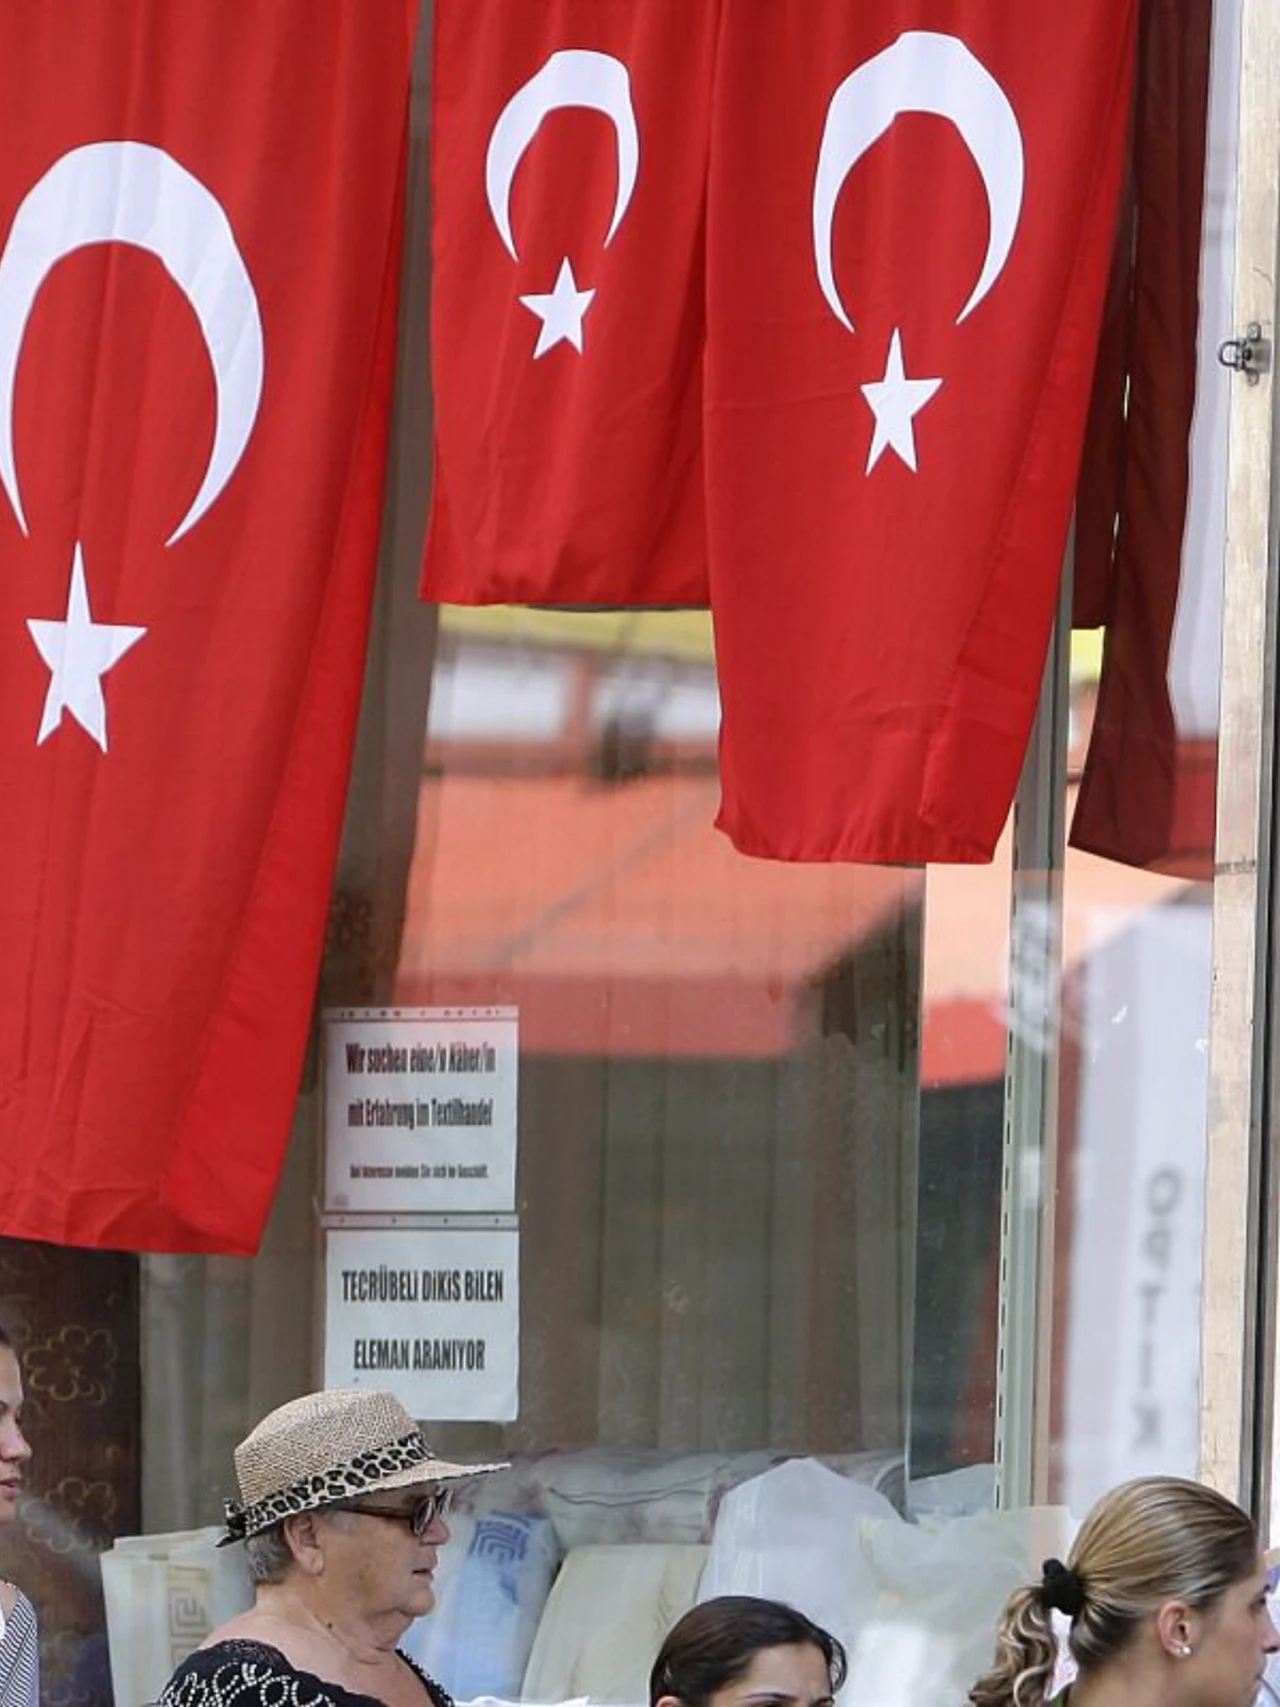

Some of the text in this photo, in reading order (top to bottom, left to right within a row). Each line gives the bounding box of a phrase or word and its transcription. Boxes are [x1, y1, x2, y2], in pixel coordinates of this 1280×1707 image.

[346, 1041, 365, 1073] Wir
[367, 1041, 408, 1073] suchen
[410, 1041, 447, 1073] eine/n
[348, 1098, 493, 1130] mit Erfahrung im Textilhandel
[353, 1339, 486, 1370] ELEMAN ARANIYOR
